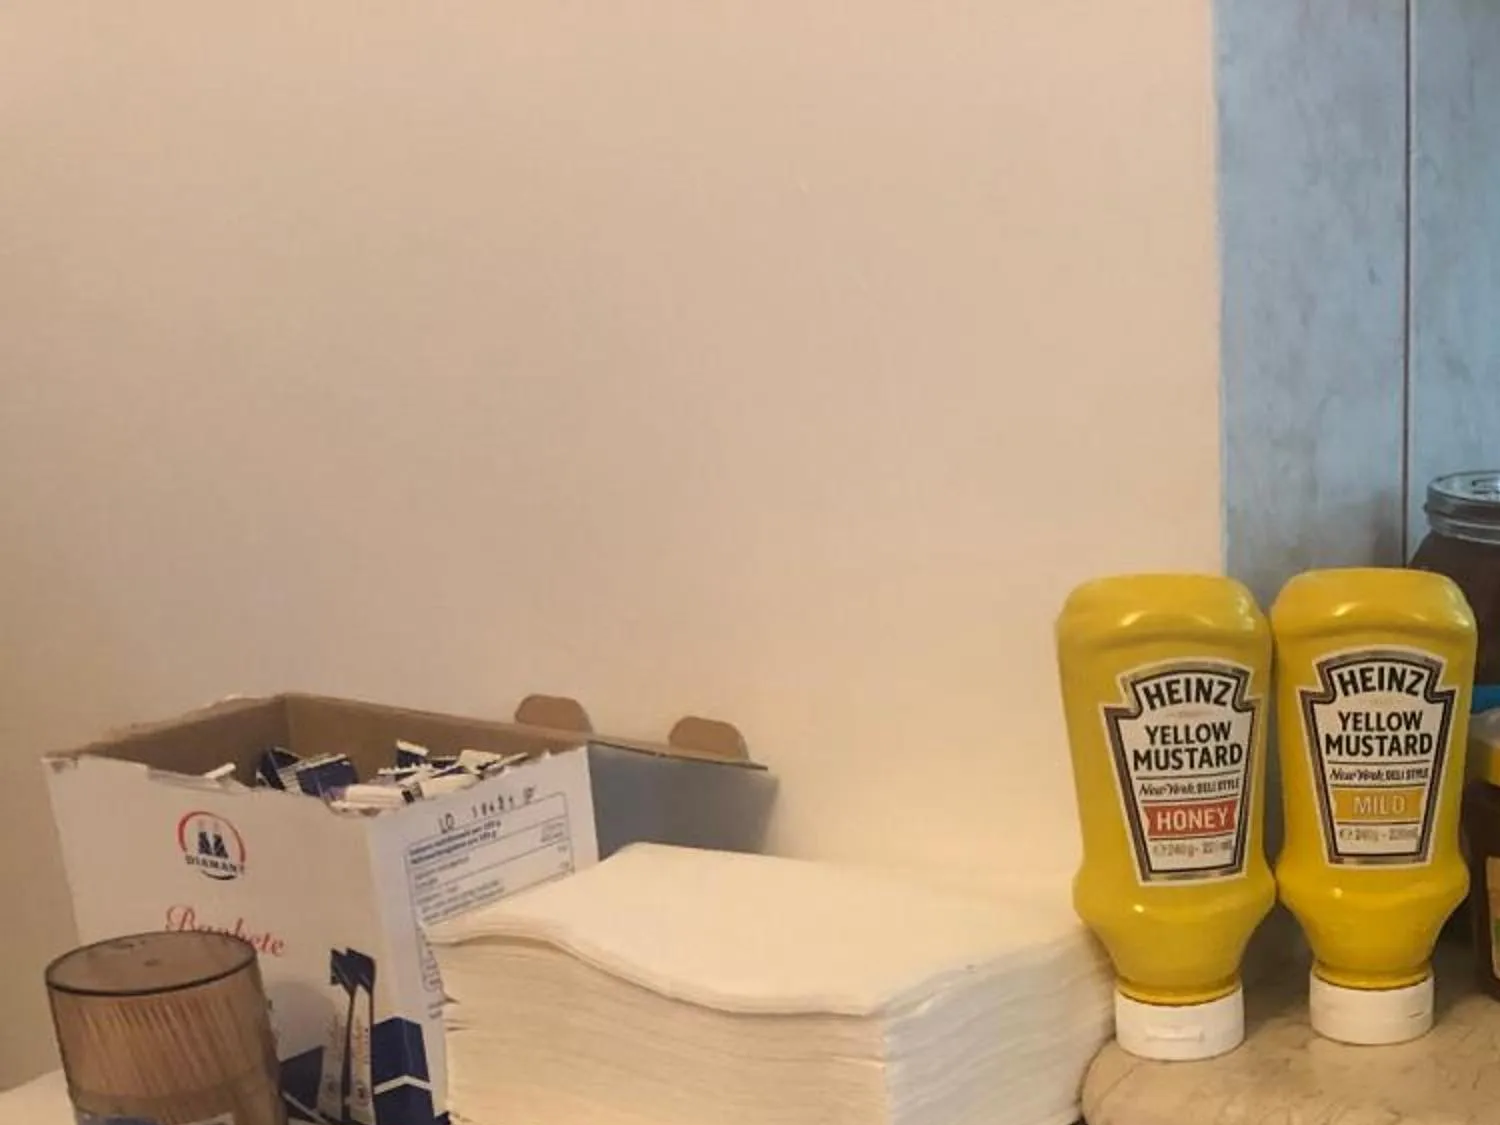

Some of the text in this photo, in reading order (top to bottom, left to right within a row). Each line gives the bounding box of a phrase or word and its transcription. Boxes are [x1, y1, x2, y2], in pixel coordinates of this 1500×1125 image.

[1338, 666, 1425, 697] HEINZ
[1142, 677, 1232, 711] HEINZ
[1145, 721, 1232, 745] YELLOW
[1338, 710, 1423, 732] YELLOW
[1133, 743, 1243, 771] MUSTARD
[1325, 733, 1433, 757] MUSTARD
[1354, 795, 1405, 815] MILD
[1157, 806, 1228, 831] HONEY
